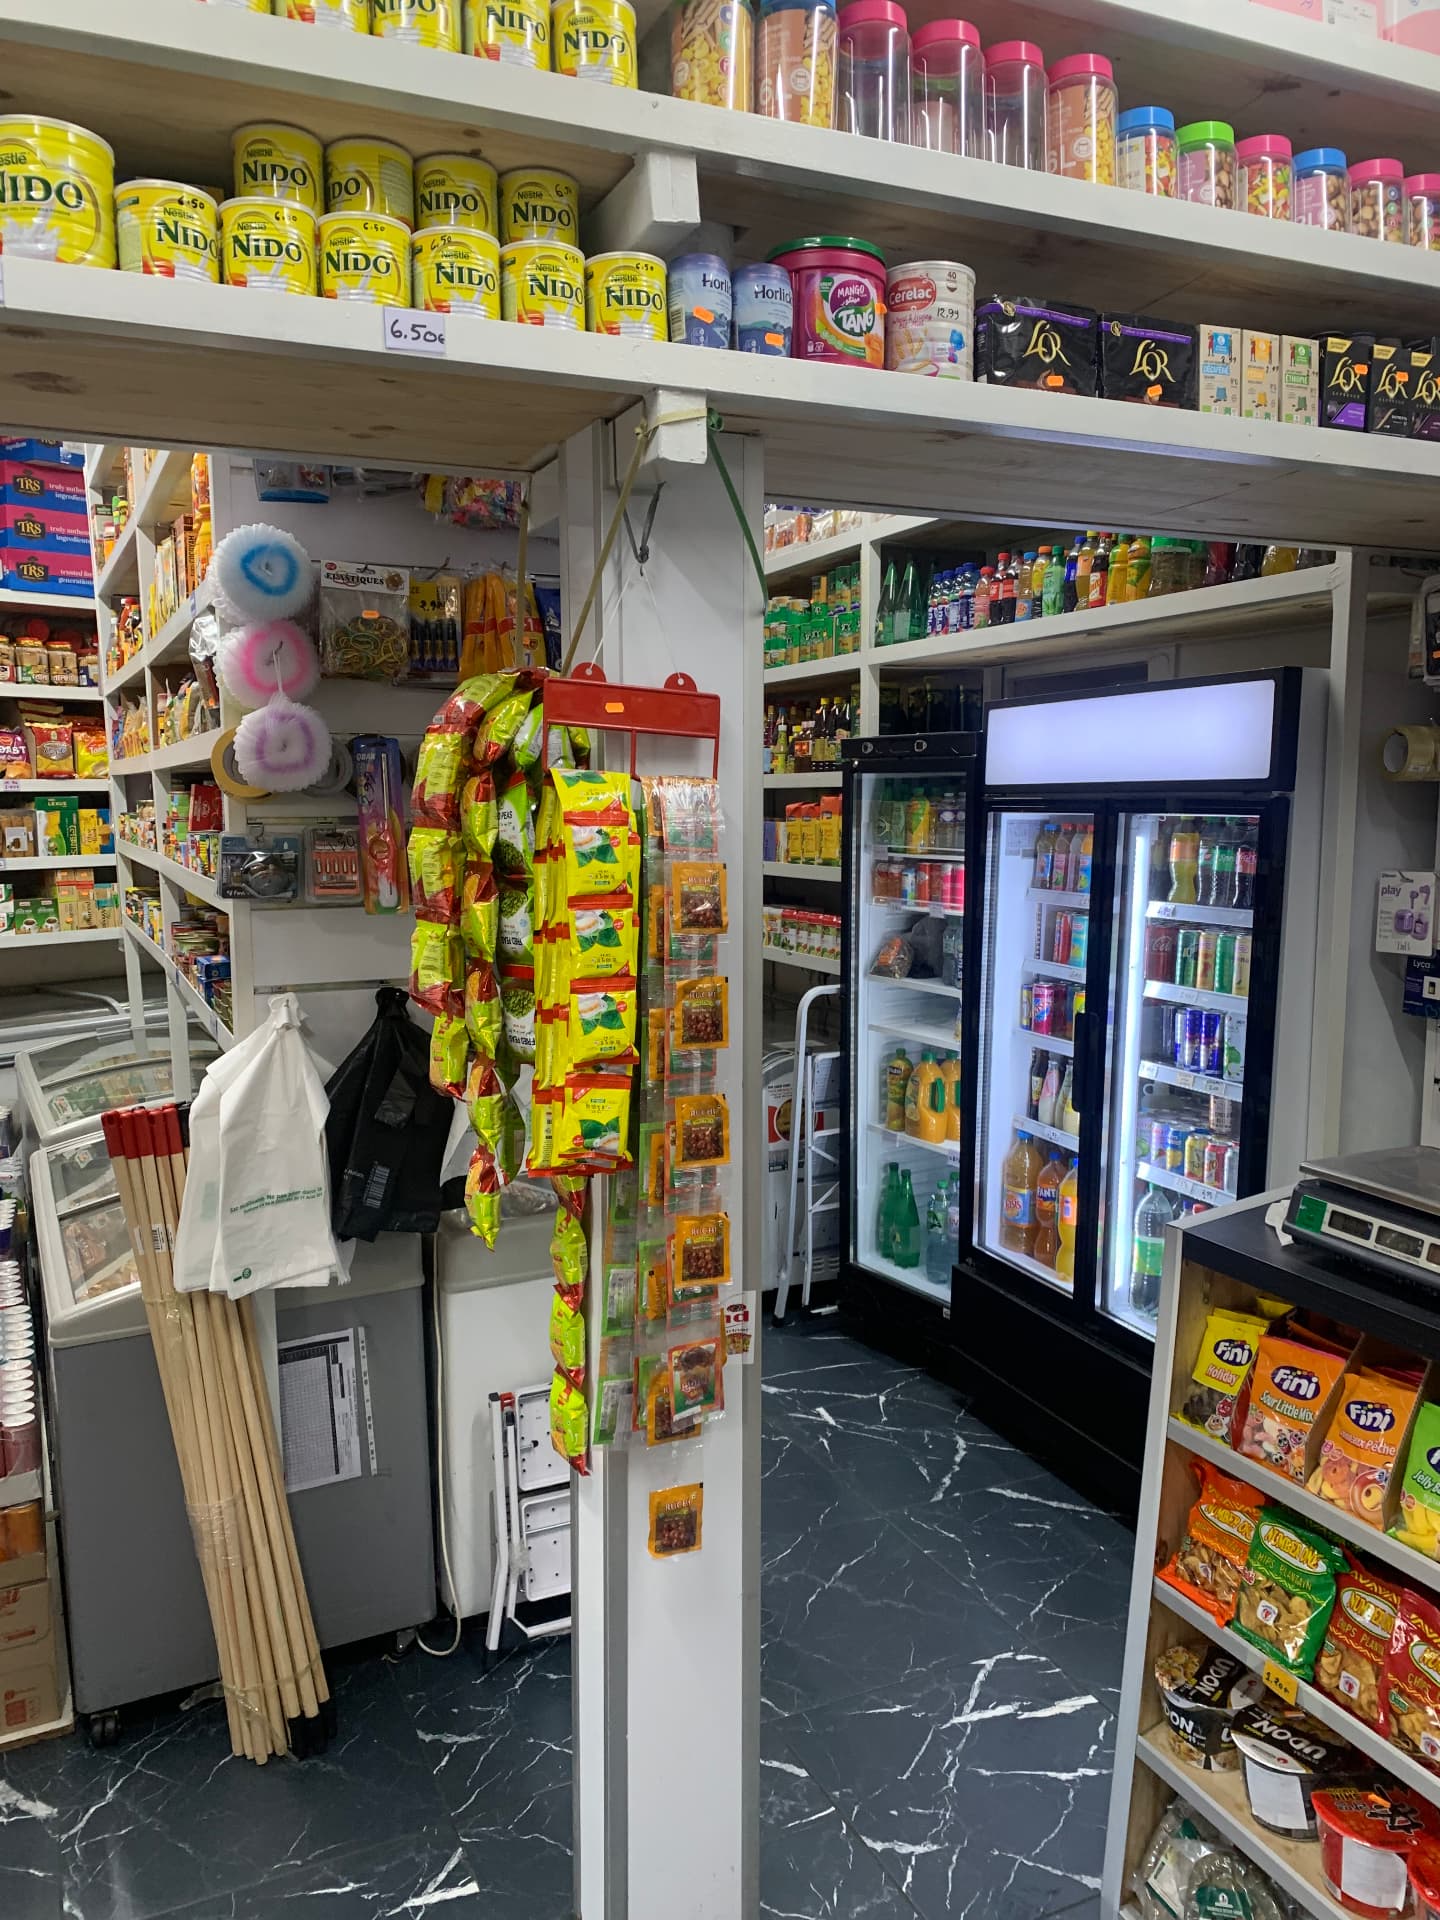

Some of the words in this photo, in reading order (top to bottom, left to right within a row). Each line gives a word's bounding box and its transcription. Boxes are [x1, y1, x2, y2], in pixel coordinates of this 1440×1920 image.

[485, 5, 546, 42] NIDO
[563, 28, 625, 54] NIDO
[242, 159, 308, 186] NIDO
[419, 190, 479, 214] NIDO
[513, 201, 571, 227] NIDO
[156, 217, 218, 260] NIDO
[232, 233, 302, 262] NIDO
[326, 249, 391, 275] NIDO
[435, 262, 496, 292] NIDO
[529, 274, 583, 305] NIDO
[605, 285, 663, 311] NIDO
[837, 284, 865, 298] MANGO
[840, 307, 874, 333] TANG
[16, 476, 41, 492] TRS
[17, 520, 42, 535] TRS
[20, 564, 45, 578] TRS
[1381, 885, 1402, 897] play
[1215, 1341, 1250, 1365] Fini
[1206, 1364, 1239, 1387] Holiday
[1274, 1368, 1319, 1399] Fini
[1260, 1390, 1278, 1408] Sour
[1275, 1400, 1298, 1419] Little
[1350, 1403, 1393, 1430] Fini
[1413, 1469, 1435, 1489] Jelly
[1251, 1718, 1327, 1760] UDON
